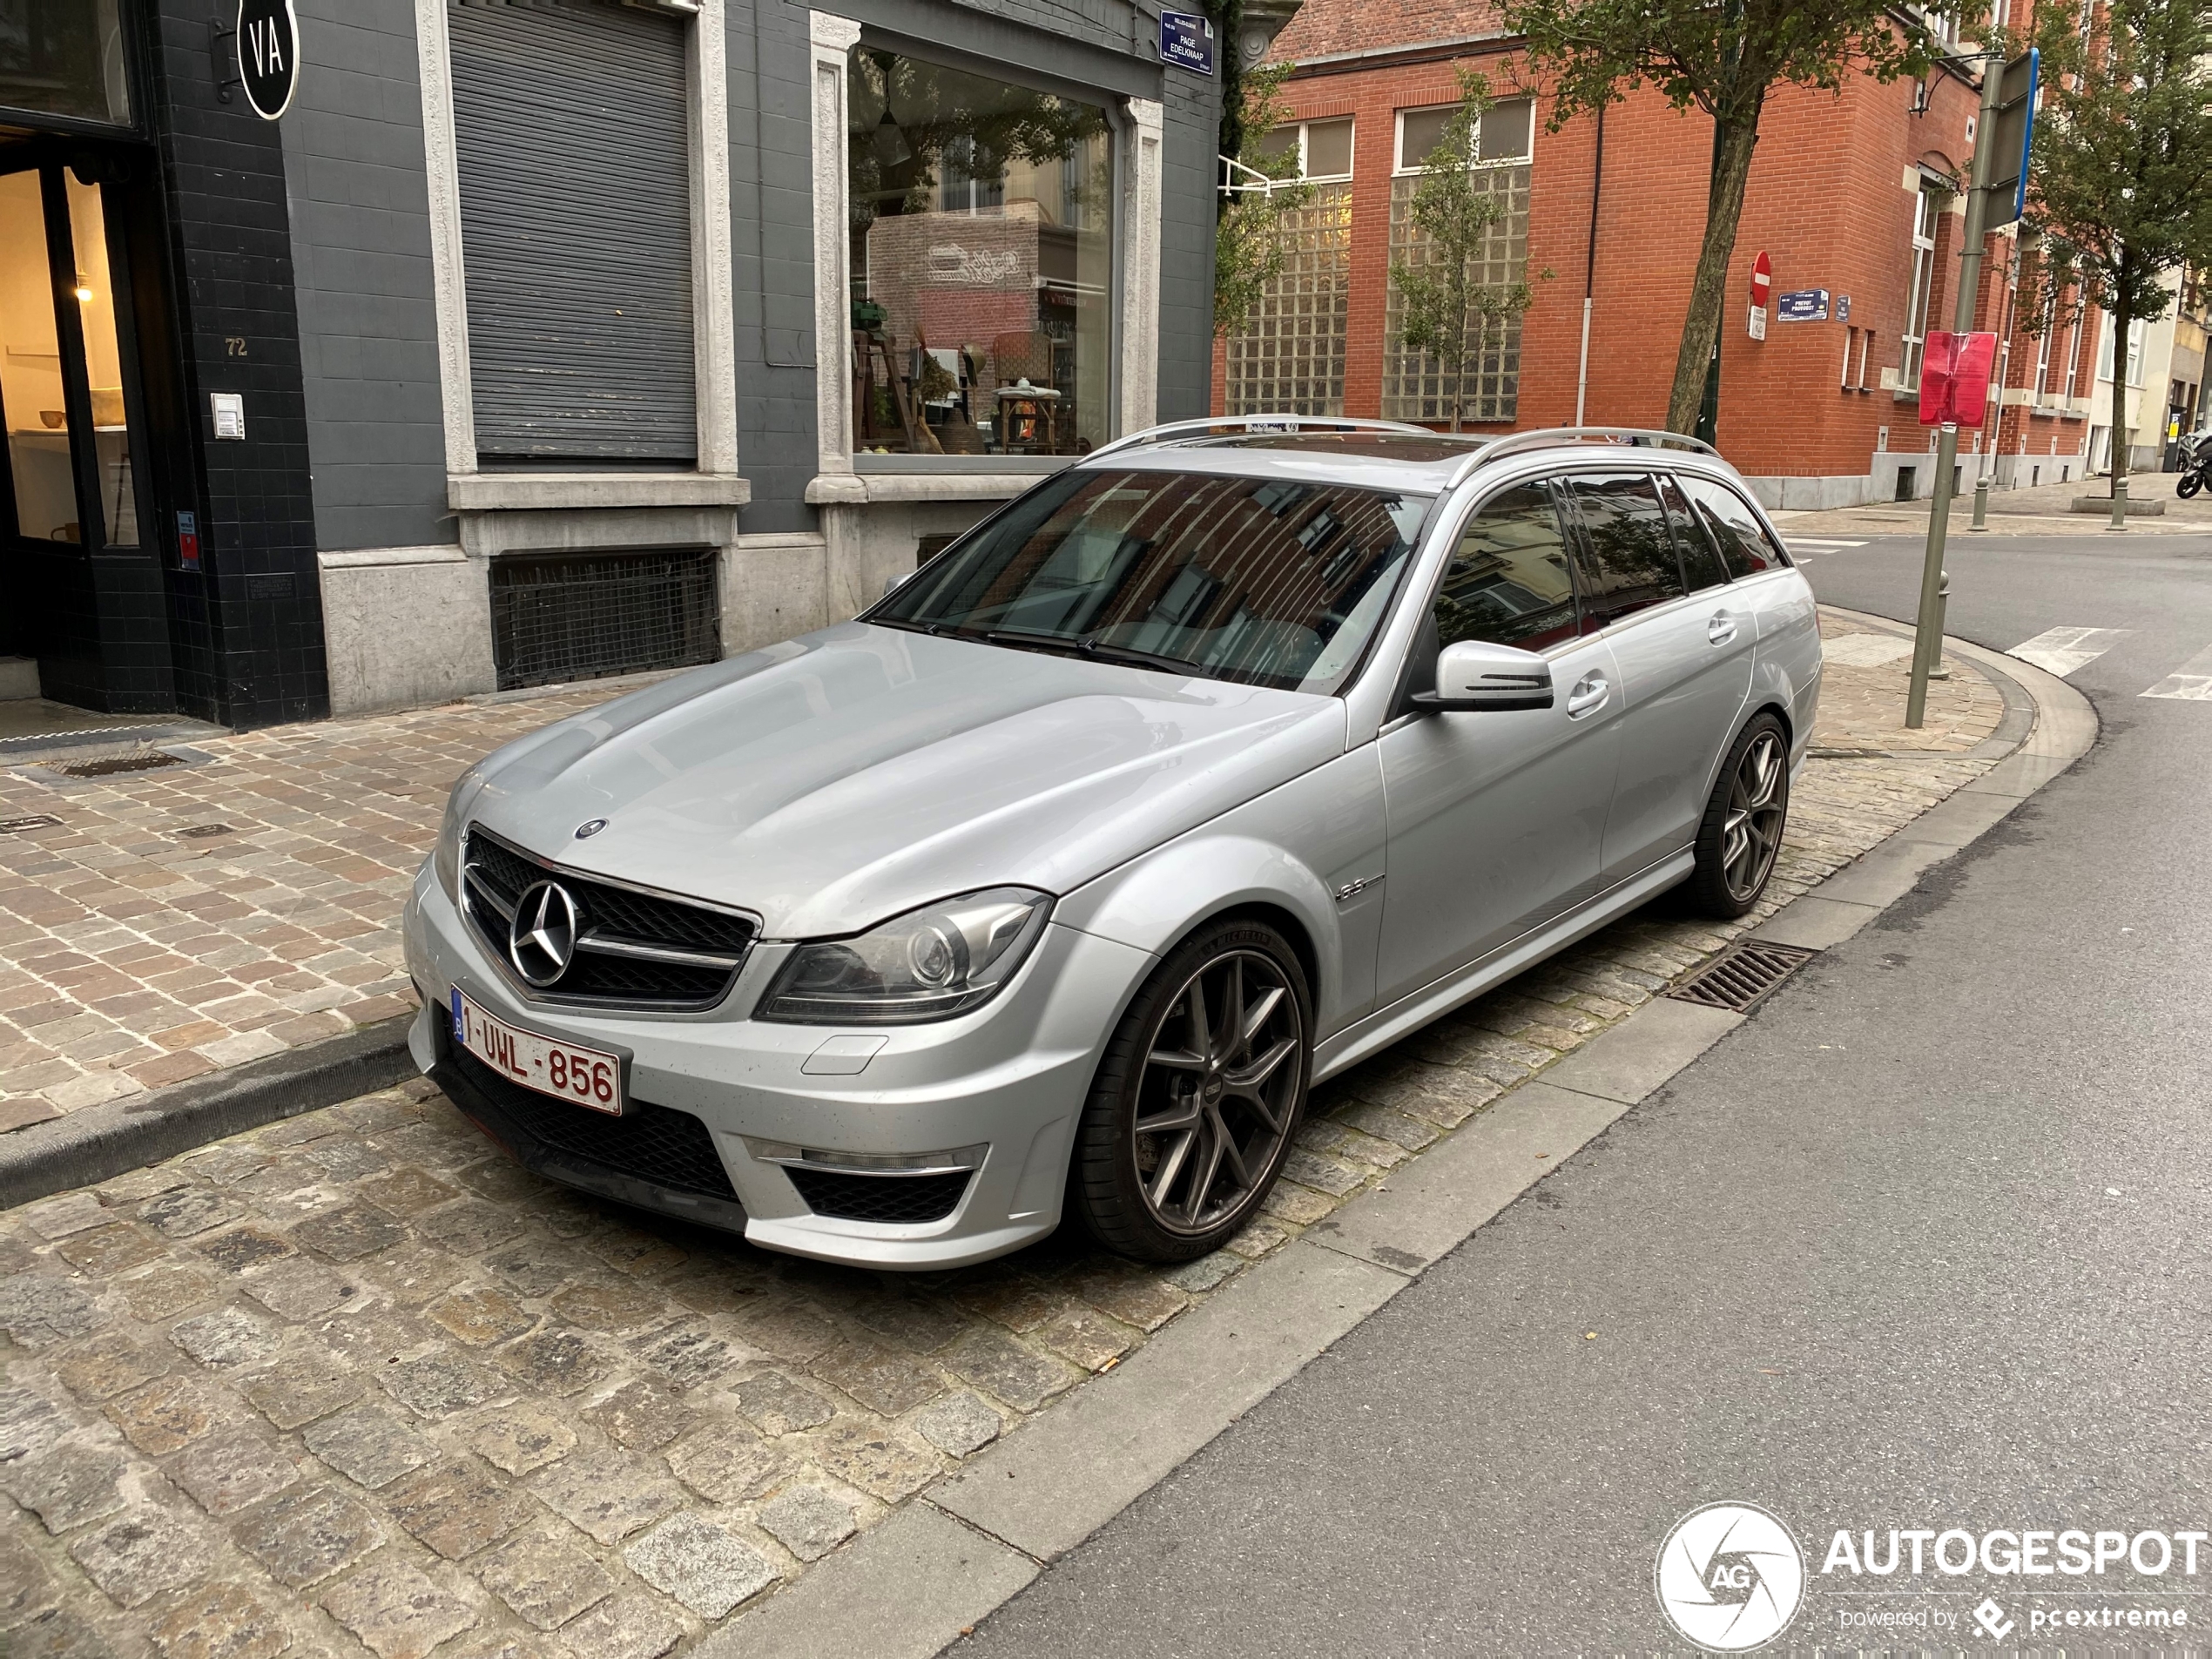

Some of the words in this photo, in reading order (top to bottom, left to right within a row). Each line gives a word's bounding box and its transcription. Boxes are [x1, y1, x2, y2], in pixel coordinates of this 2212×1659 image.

[248, 16, 285, 78] VA
[1180, 35, 1196, 48] PAGE
[1170, 43, 1204, 61] EDELKNAAP
[225, 337, 247, 356] 72
[1217, 929, 1271, 947] MICHELIN
[455, 1016, 462, 1035] B
